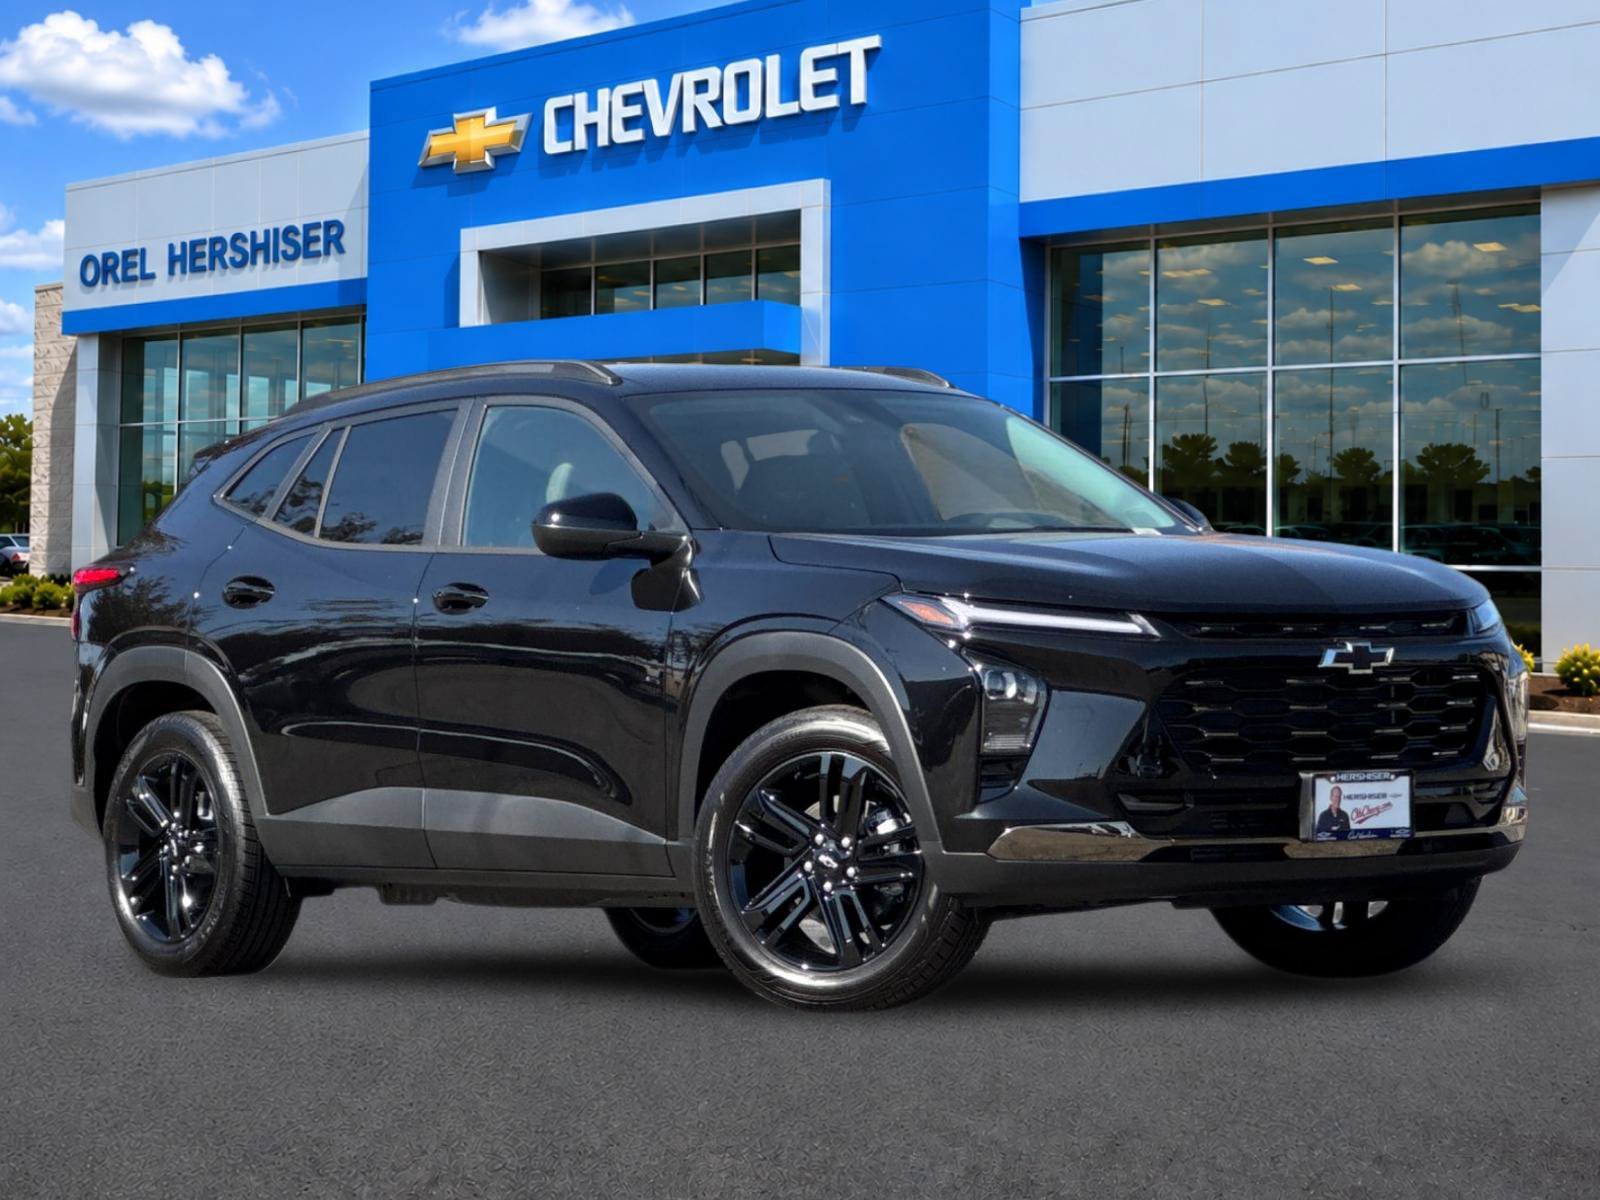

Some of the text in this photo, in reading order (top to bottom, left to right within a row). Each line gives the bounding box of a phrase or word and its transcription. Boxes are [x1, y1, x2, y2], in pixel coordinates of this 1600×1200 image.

[544, 34, 882, 155] CHEVROLET
[79, 218, 346, 288] OREL HERSHISER
[1336, 772, 1391, 782] HERSHISER
[1343, 793, 1388, 801] HERSHISER
